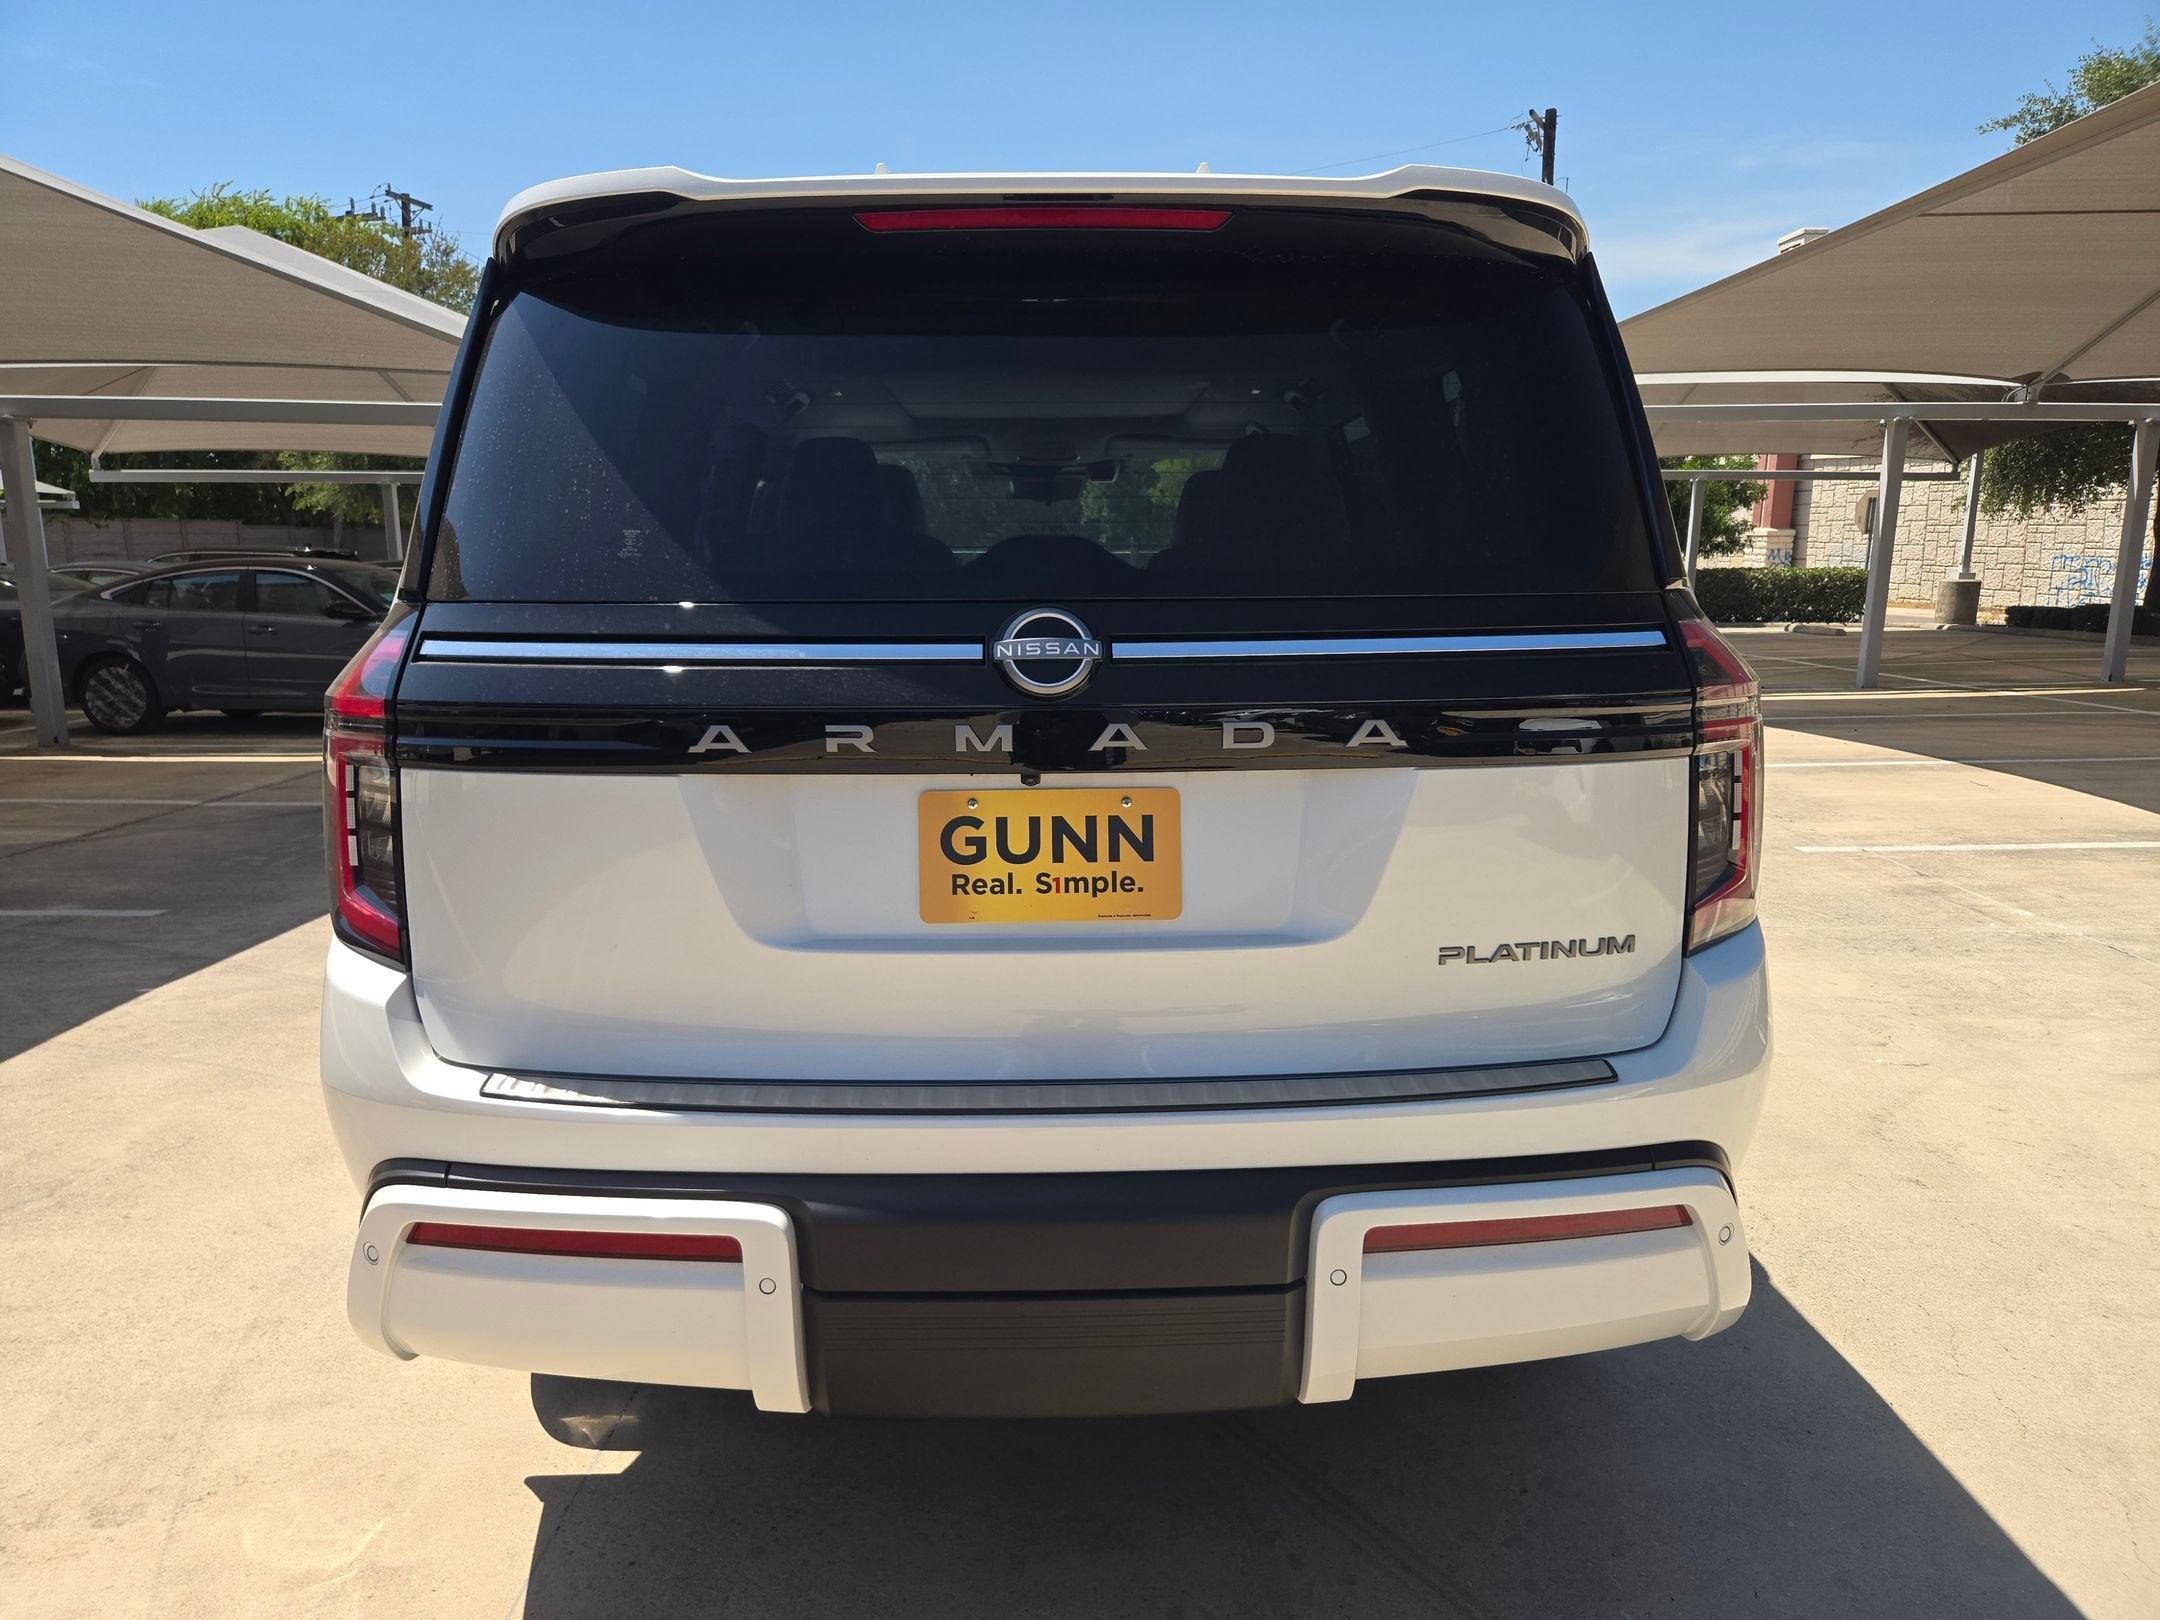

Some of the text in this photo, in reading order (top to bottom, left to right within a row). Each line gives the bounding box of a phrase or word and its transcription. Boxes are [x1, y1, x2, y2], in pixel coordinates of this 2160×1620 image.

[997, 642, 1099, 657] NISSAN
[689, 719, 1408, 752] ARMADA
[940, 814, 1155, 865] GUNN
[952, 873, 1022, 895] Real.
[1438, 934, 1636, 966] PLATINUM
